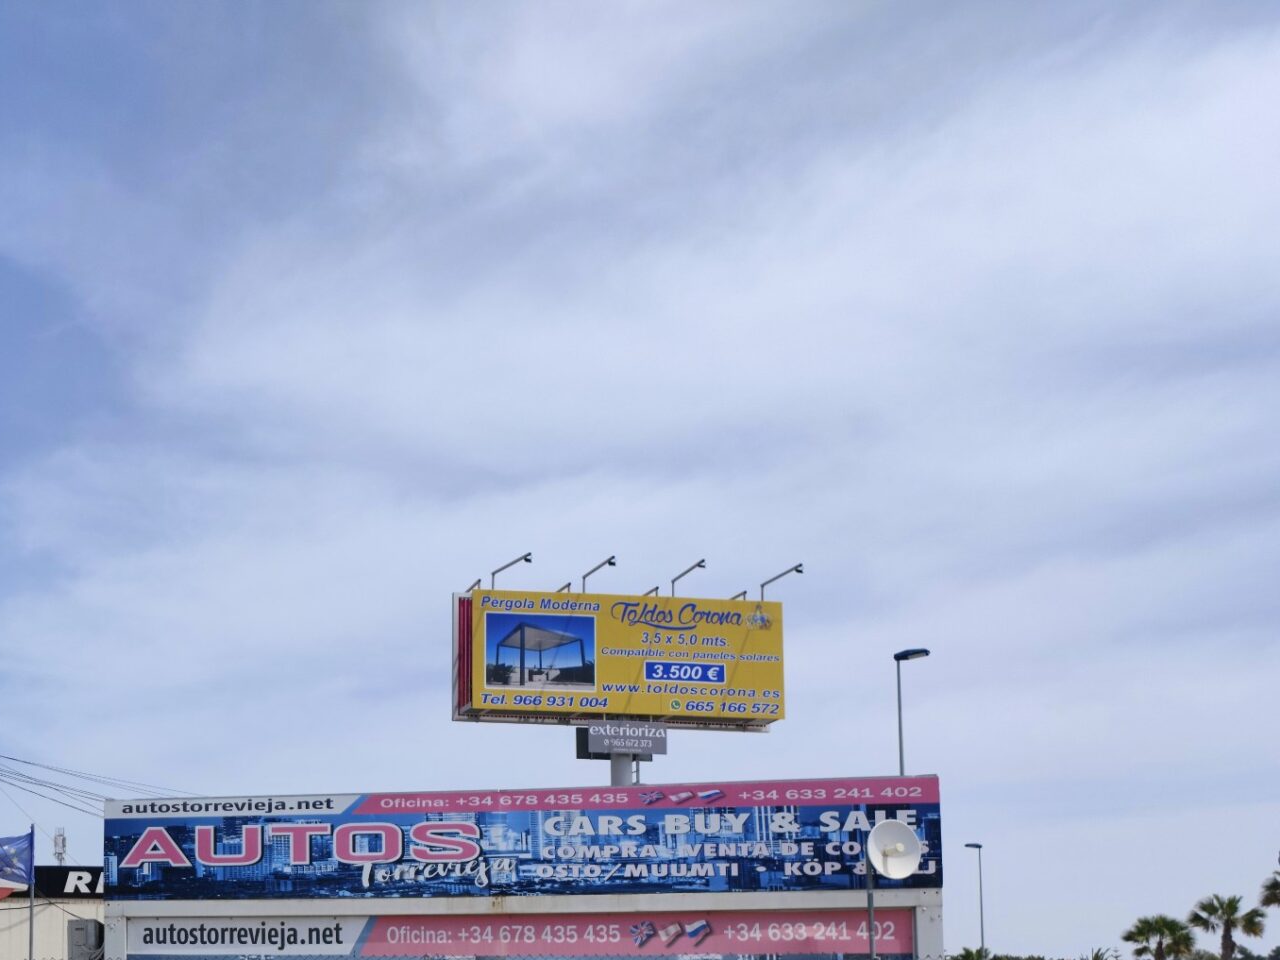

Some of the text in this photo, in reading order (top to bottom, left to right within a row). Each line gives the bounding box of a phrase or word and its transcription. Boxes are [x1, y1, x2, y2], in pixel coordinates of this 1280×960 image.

[540, 598, 600, 611] Moderna
[611, 601, 742, 629] Toldos Corona
[641, 632, 661, 645] 3,5
[665, 635, 673, 644] x
[701, 636, 730, 647] mts.
[601, 647, 665, 658] Compatible
[692, 651, 736, 661] paneles
[739, 653, 780, 662] solares
[652, 664, 720, 681] 3.500 €
[602, 683, 780, 698] www.toldoscorona.es
[481, 693, 609, 708] Tel. 966 931 004
[685, 701, 780, 714] 665 166 572
[590, 724, 666, 737] exterioriza
[122, 798, 334, 814] autostorrevieja.net
[380, 787, 922, 808] Oficina: +34 678 435 435 +34 633 241 402
[543, 814, 647, 836] CARS
[664, 813, 751, 835] BUY
[771, 812, 801, 833] &
[119, 821, 482, 869] AUTOS
[541, 844, 659, 859] COMPRA
[683, 842, 771, 857] VENTA
[781, 842, 814, 855] DE
[351, 856, 518, 888] Torrevieja
[784, 859, 842, 876] KÖP
[143, 921, 343, 950] autostorrevieja.net
[386, 920, 895, 944] Oficina: +34 678 435 435 +34 633 241 402
